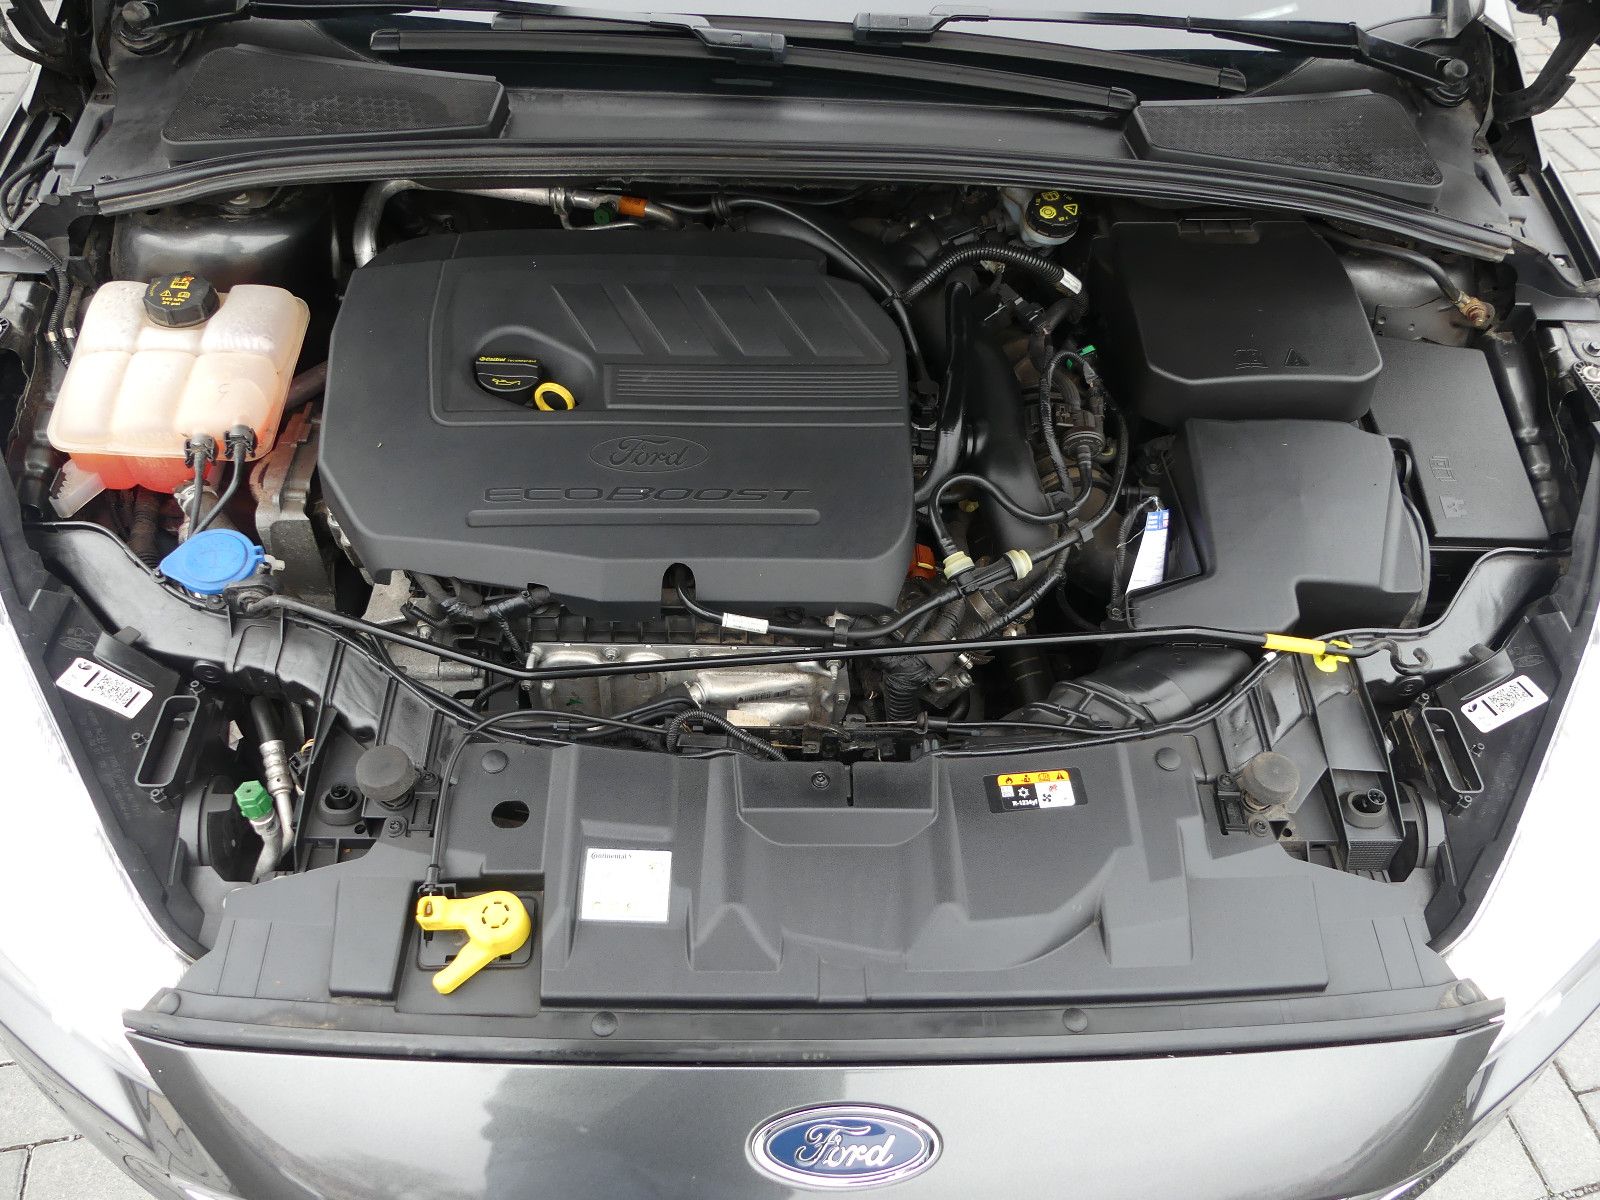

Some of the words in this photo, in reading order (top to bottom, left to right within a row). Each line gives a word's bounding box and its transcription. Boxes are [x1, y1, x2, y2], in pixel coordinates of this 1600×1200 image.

[608, 437, 688, 466] Ford
[591, 852, 627, 860] Continental
[794, 1123, 897, 1168] Ford
